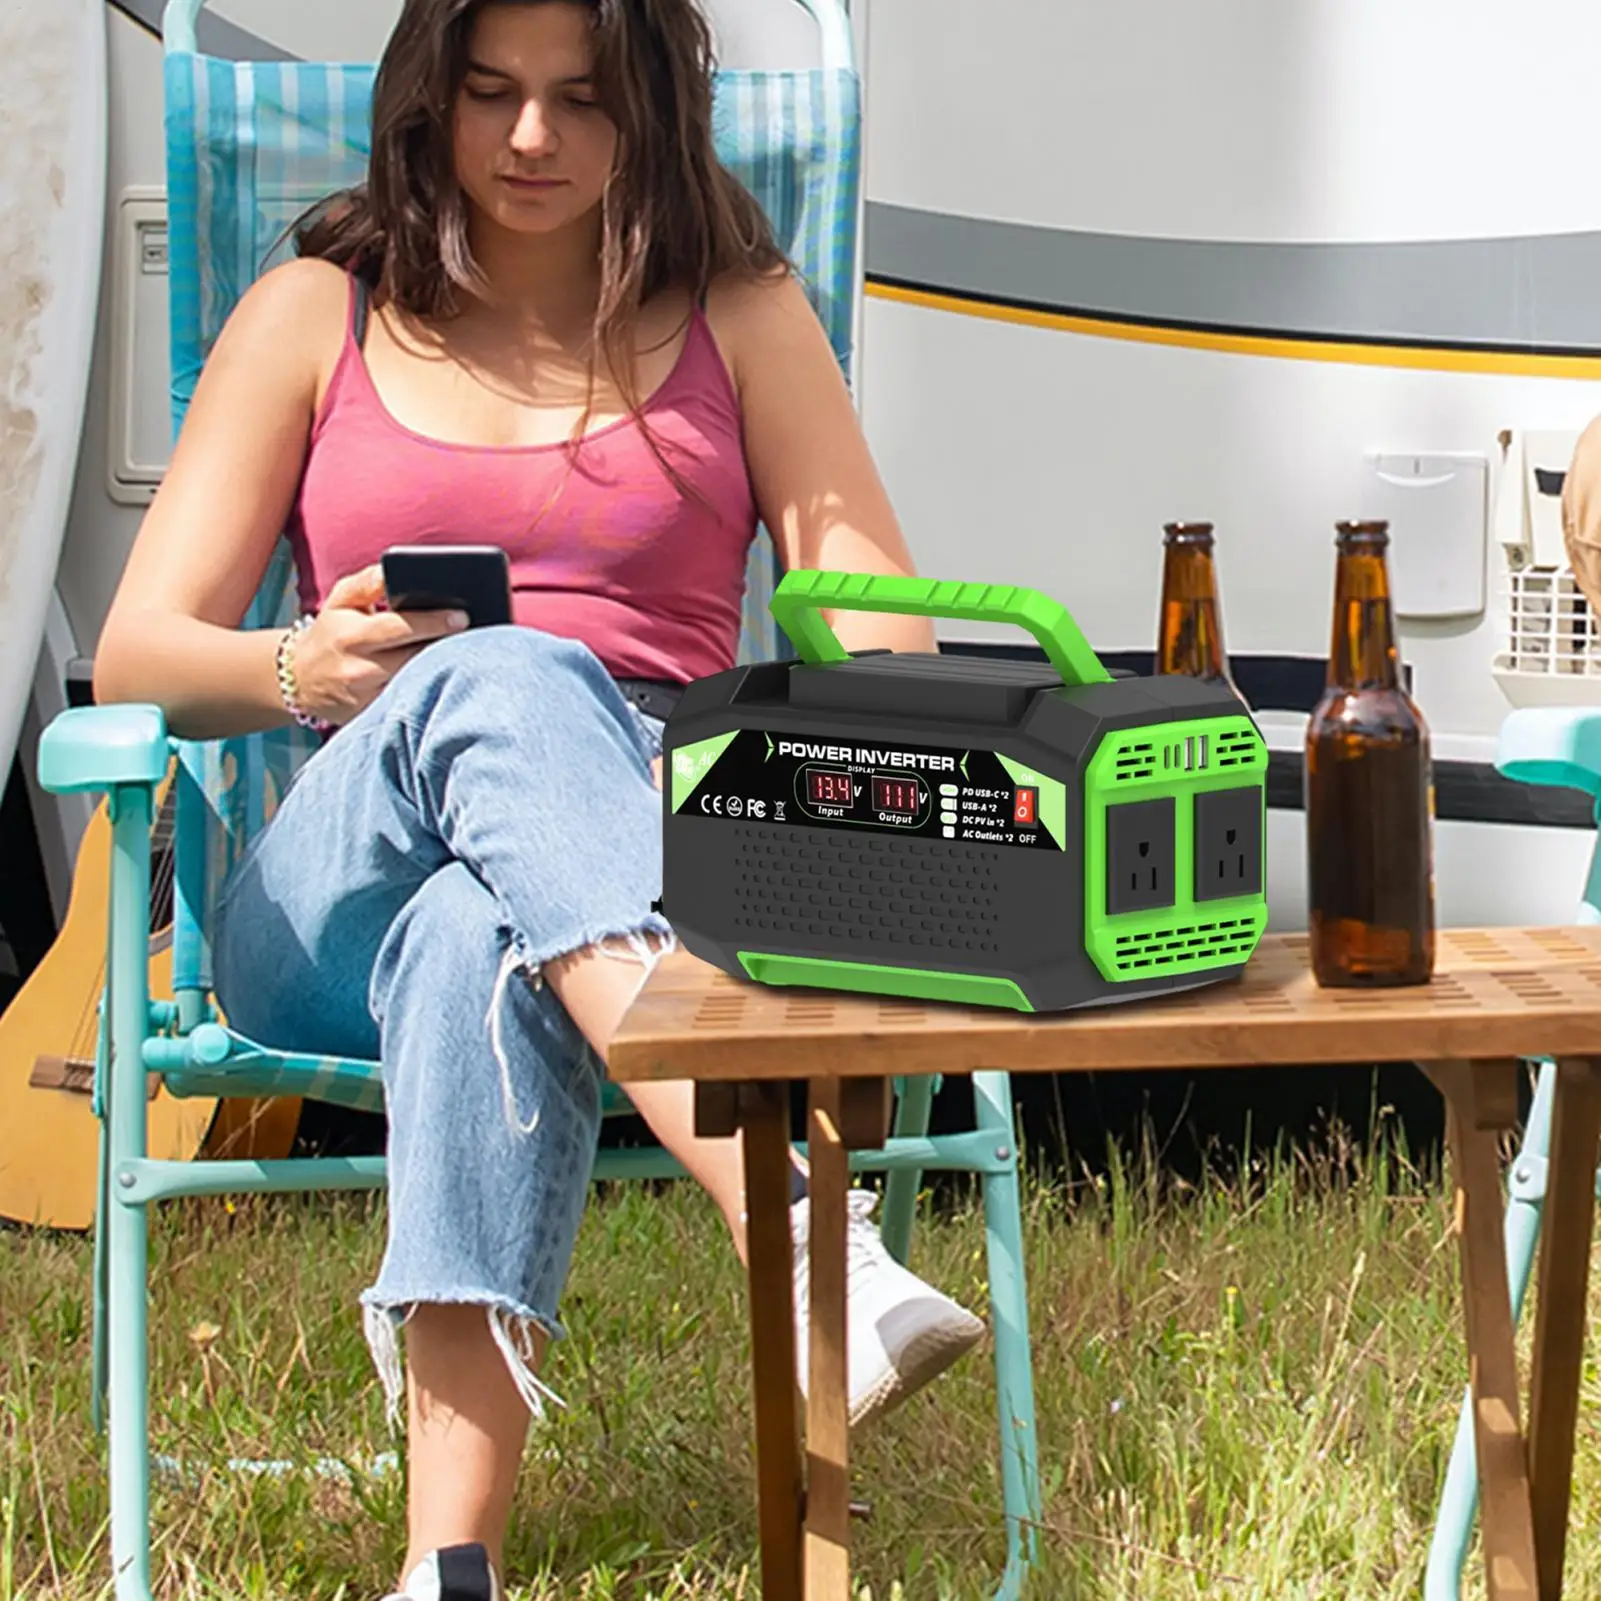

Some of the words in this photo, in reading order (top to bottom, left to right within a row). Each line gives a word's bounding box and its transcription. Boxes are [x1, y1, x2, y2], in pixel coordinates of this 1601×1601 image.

[779, 742, 852, 762] POWER
[856, 748, 955, 772] INVERTER
[847, 765, 876, 774] DISPLAY
[816, 776, 850, 801] 13.4
[853, 785, 863, 797] V
[962, 787, 974, 796] PD
[975, 788, 1000, 799] USB-C
[919, 792, 928, 804] V
[701, 794, 722, 815] CE
[962, 802, 987, 812] USB-A
[818, 806, 845, 817] Input
[879, 812, 913, 825] Output
[962, 815, 974, 825] DC
[974, 817, 987, 826] PV
[962, 829, 974, 839] AC
[975, 830, 1004, 842] Outlets
[1019, 834, 1037, 844] OFF
